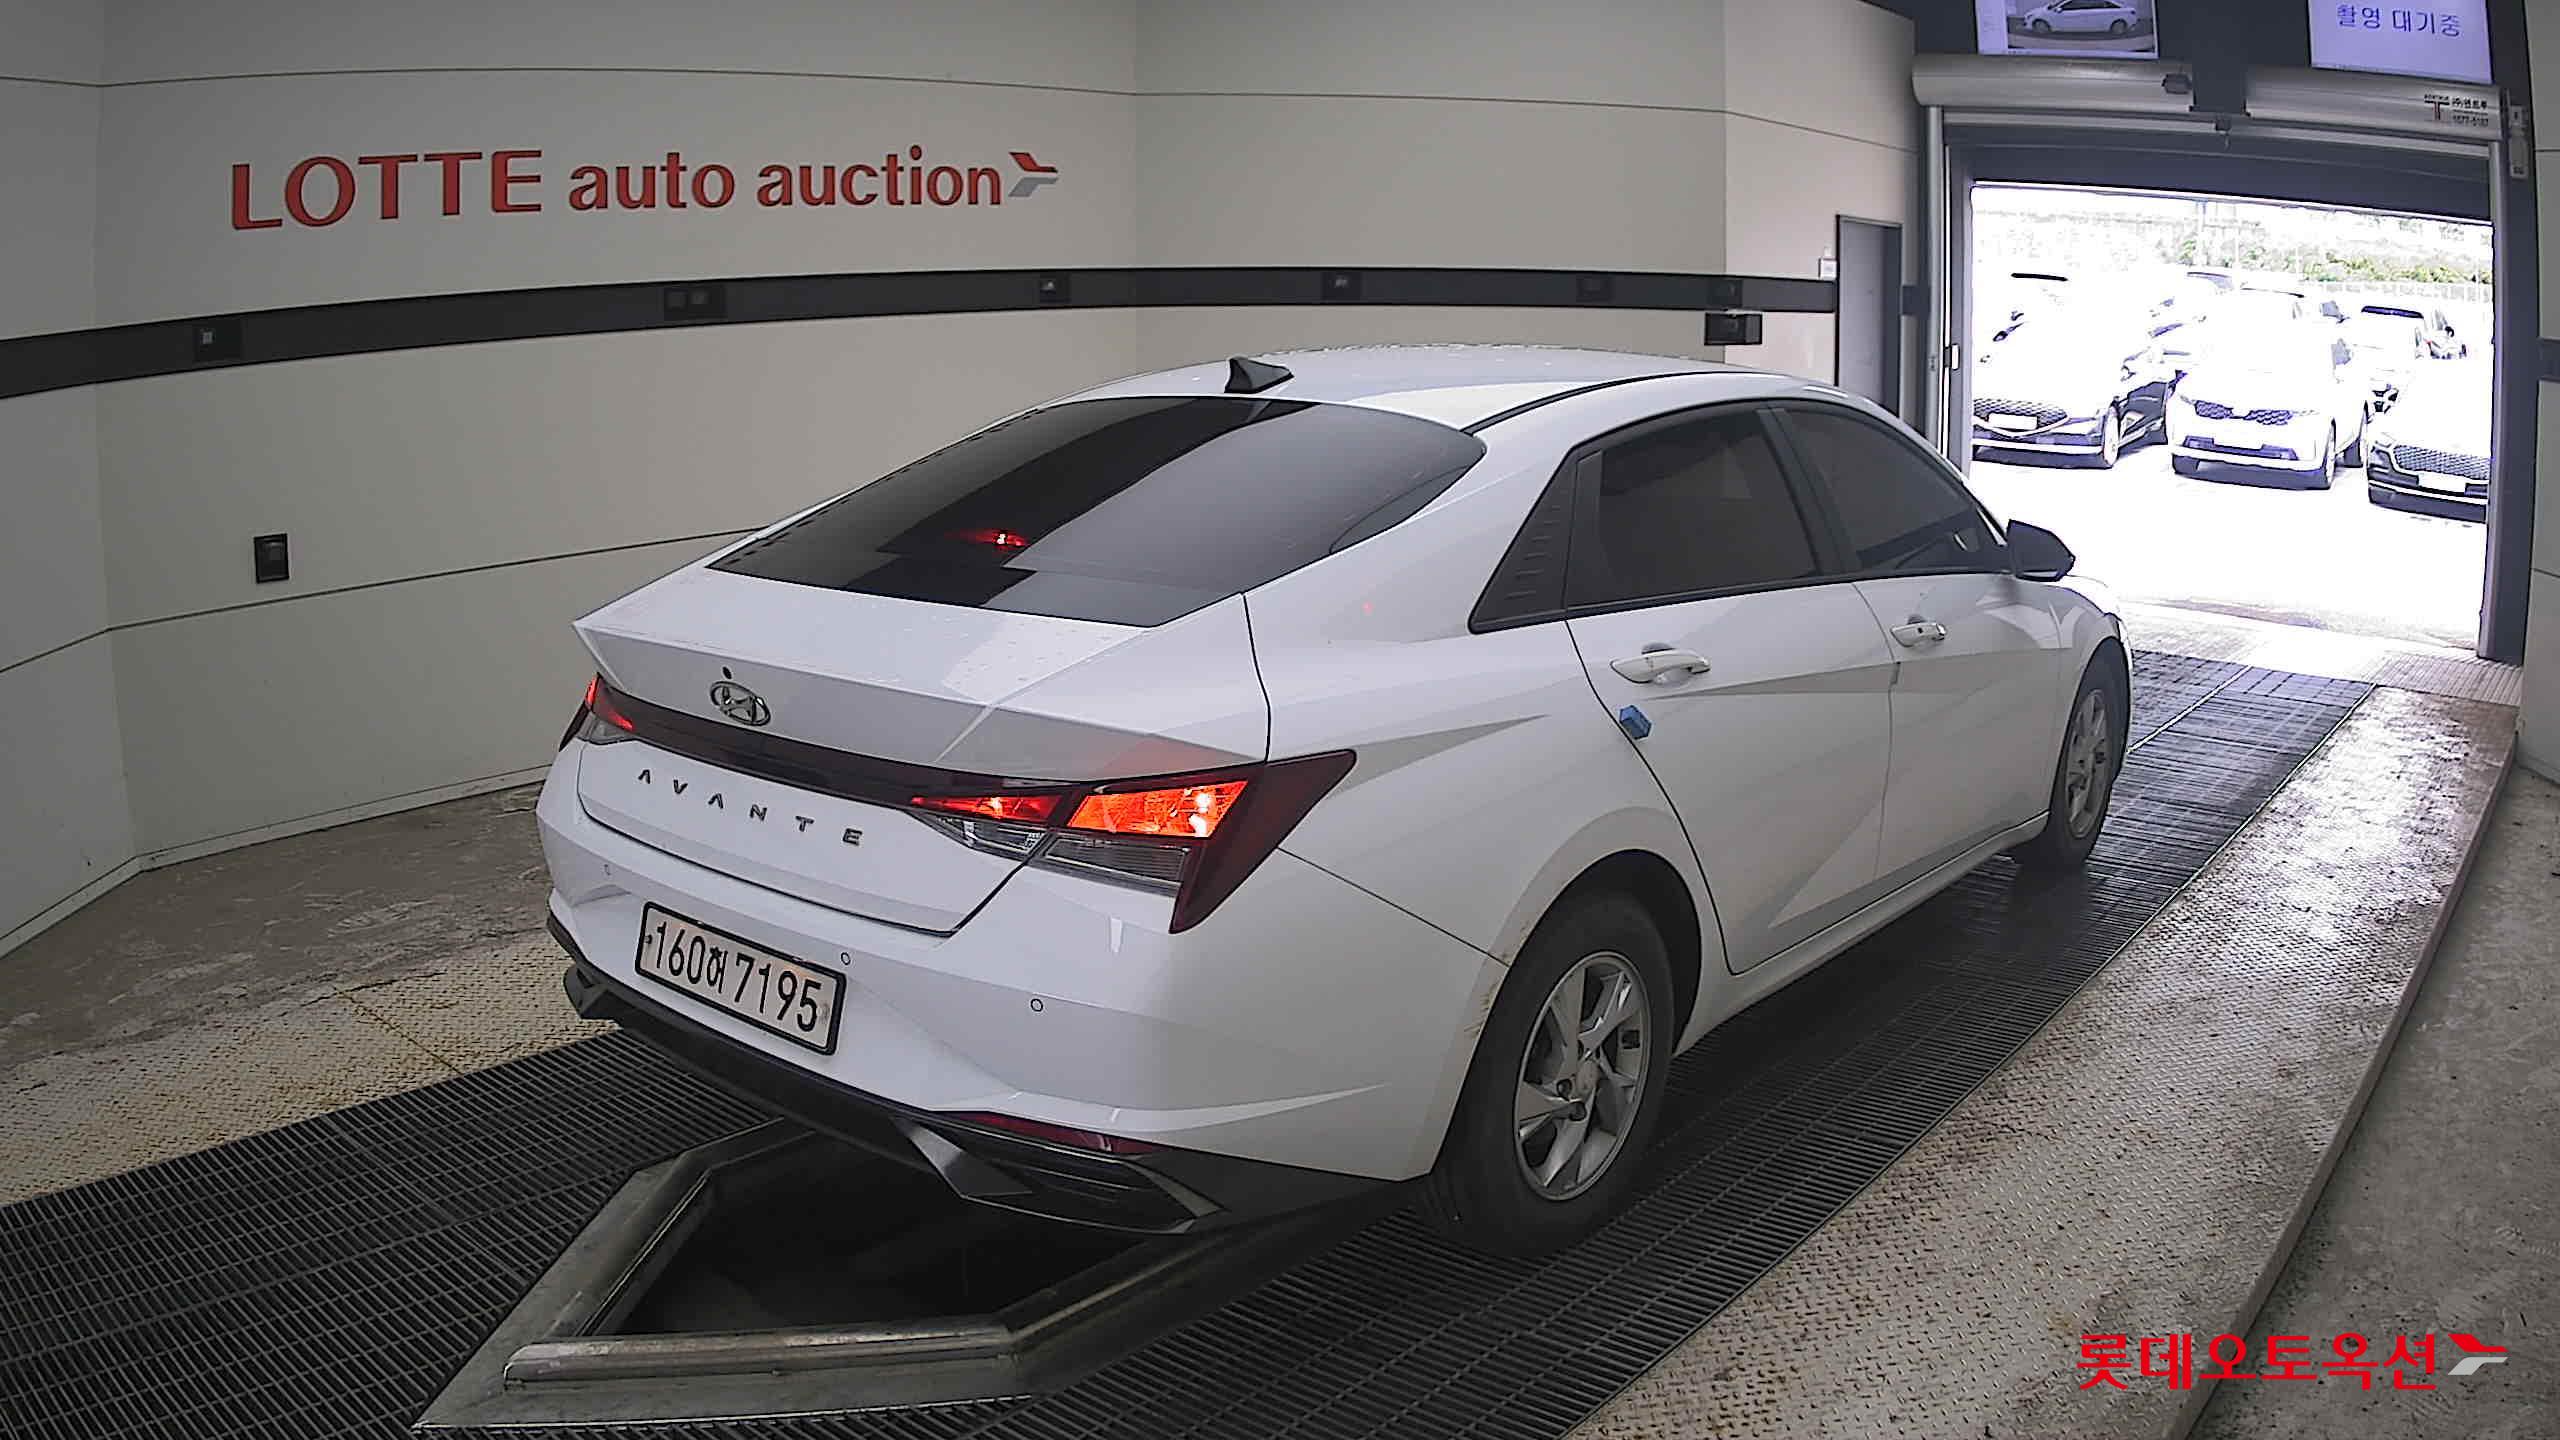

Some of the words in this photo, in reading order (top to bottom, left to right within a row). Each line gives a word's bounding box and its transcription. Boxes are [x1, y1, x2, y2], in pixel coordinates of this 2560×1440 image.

[2337, 4, 2381, 29] 촬영
[2392, 10, 2460, 37] 대기중
[231, 149, 542, 230] LOTTE
[568, 152, 736, 210] auto
[756, 144, 1002, 206] auction
[638, 768, 862, 846] AVANTE
